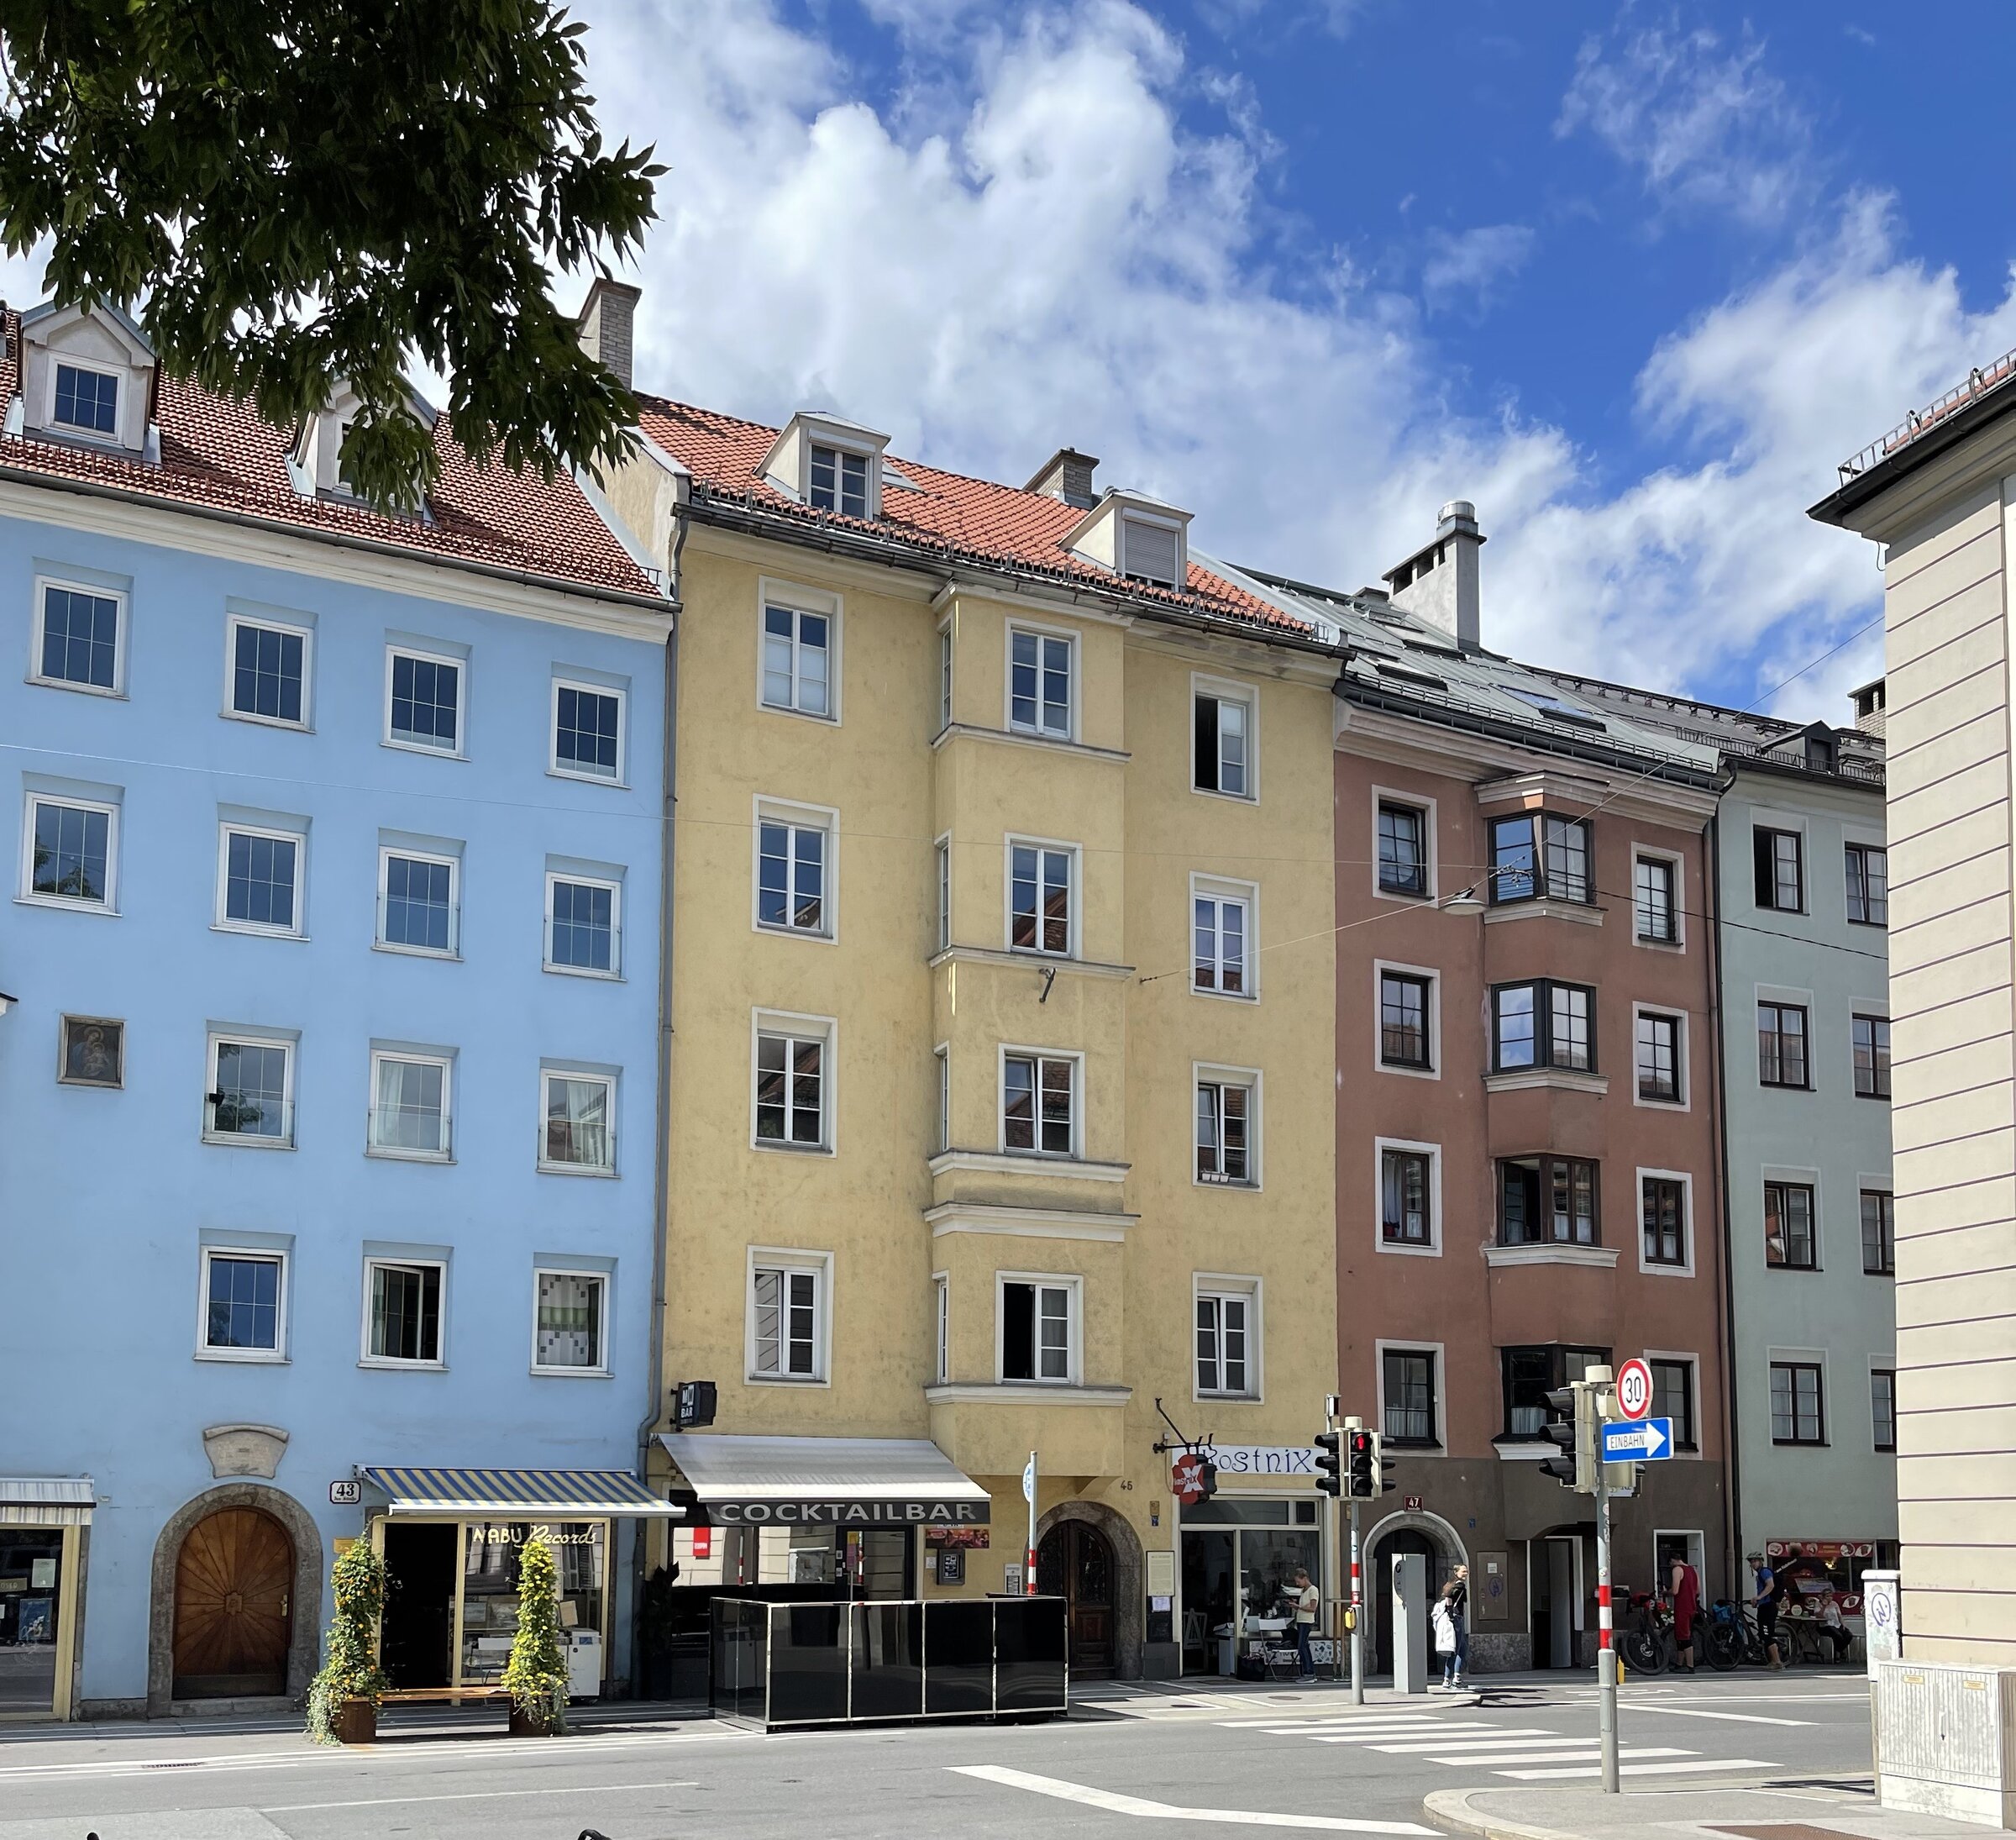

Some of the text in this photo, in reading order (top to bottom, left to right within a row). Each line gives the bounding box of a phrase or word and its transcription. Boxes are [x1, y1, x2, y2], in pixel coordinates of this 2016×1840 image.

[1625, 1375, 1642, 1403] 30
[681, 1406, 693, 1417] BAR
[1610, 1433, 1645, 1448] EINBAHN
[336, 1483, 355, 1496] 43
[1409, 1497, 1420, 1507] 47
[719, 1503, 977, 1521] COCKTAILBAR
[472, 1523, 597, 1544] NABU Records
